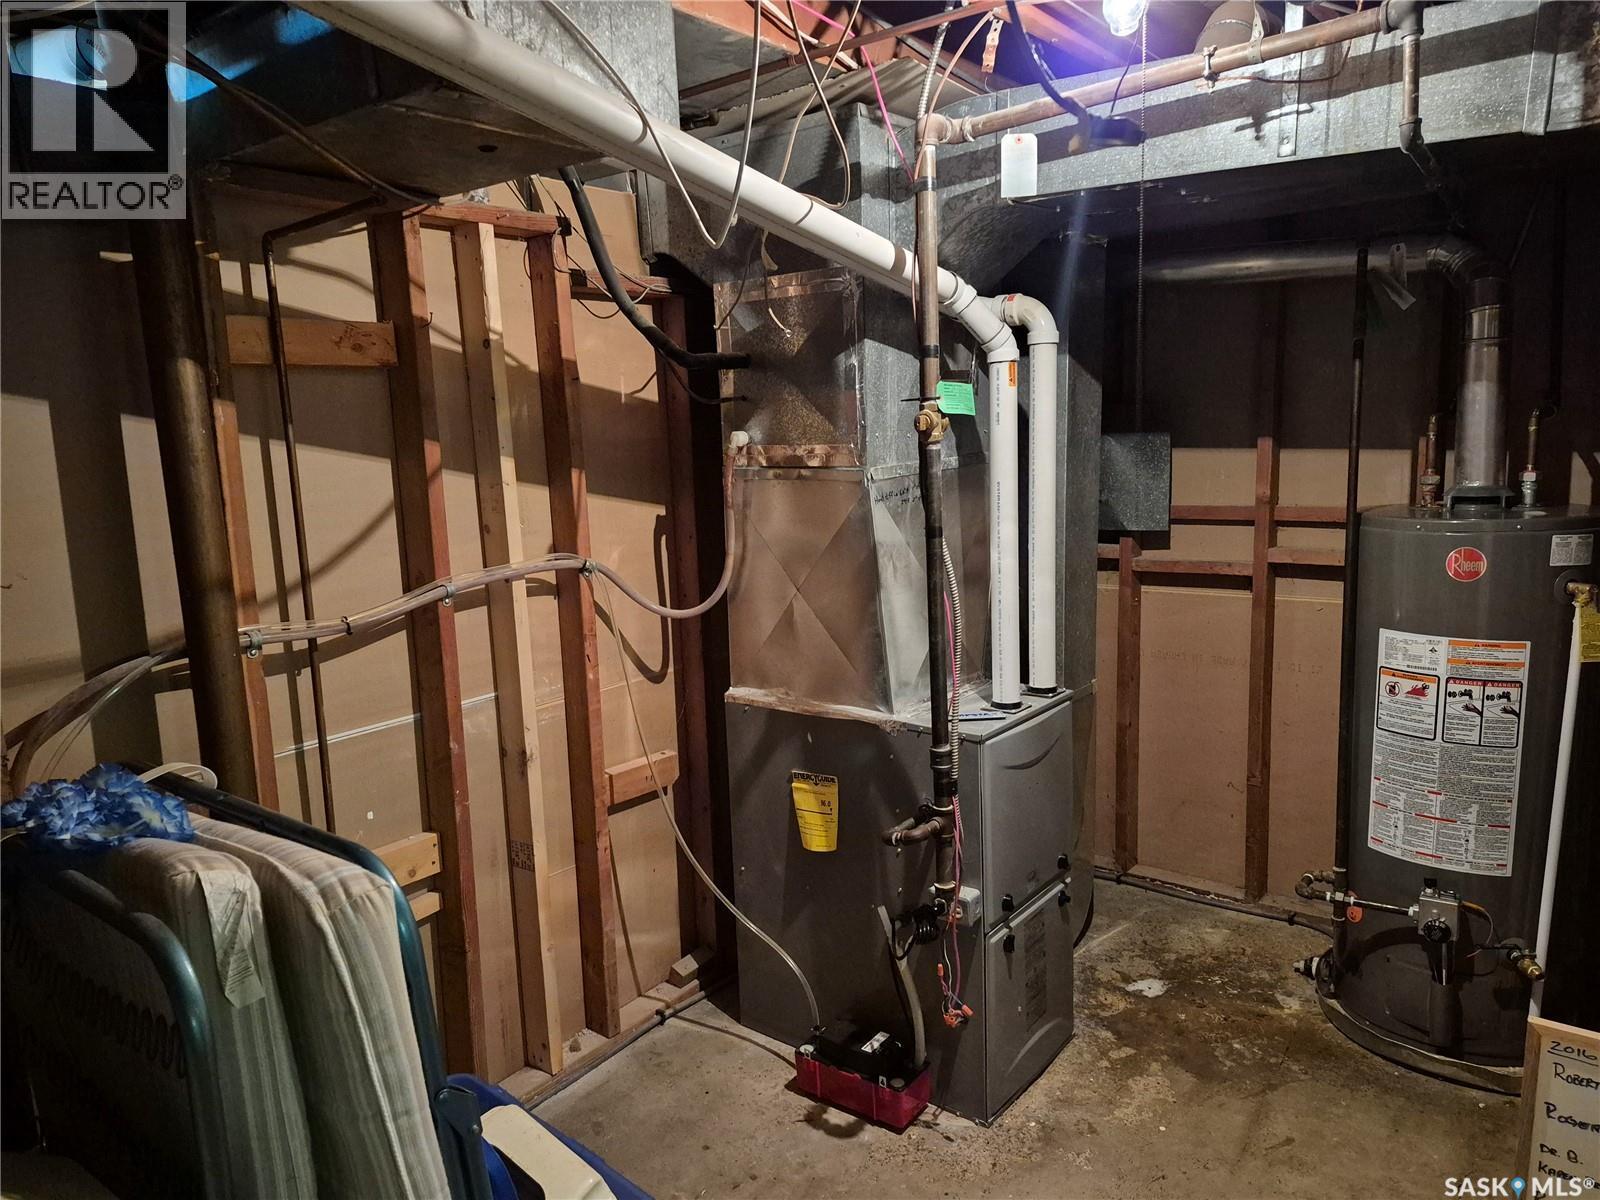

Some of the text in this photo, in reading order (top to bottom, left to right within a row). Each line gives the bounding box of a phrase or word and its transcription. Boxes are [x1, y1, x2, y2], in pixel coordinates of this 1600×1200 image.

[1451, 547, 1484, 576] Rheem
[1455, 679, 1482, 687] DANGER
[1550, 1041, 1599, 1061] 2016
[1553, 1062, 1600, 1090] ROBERT
